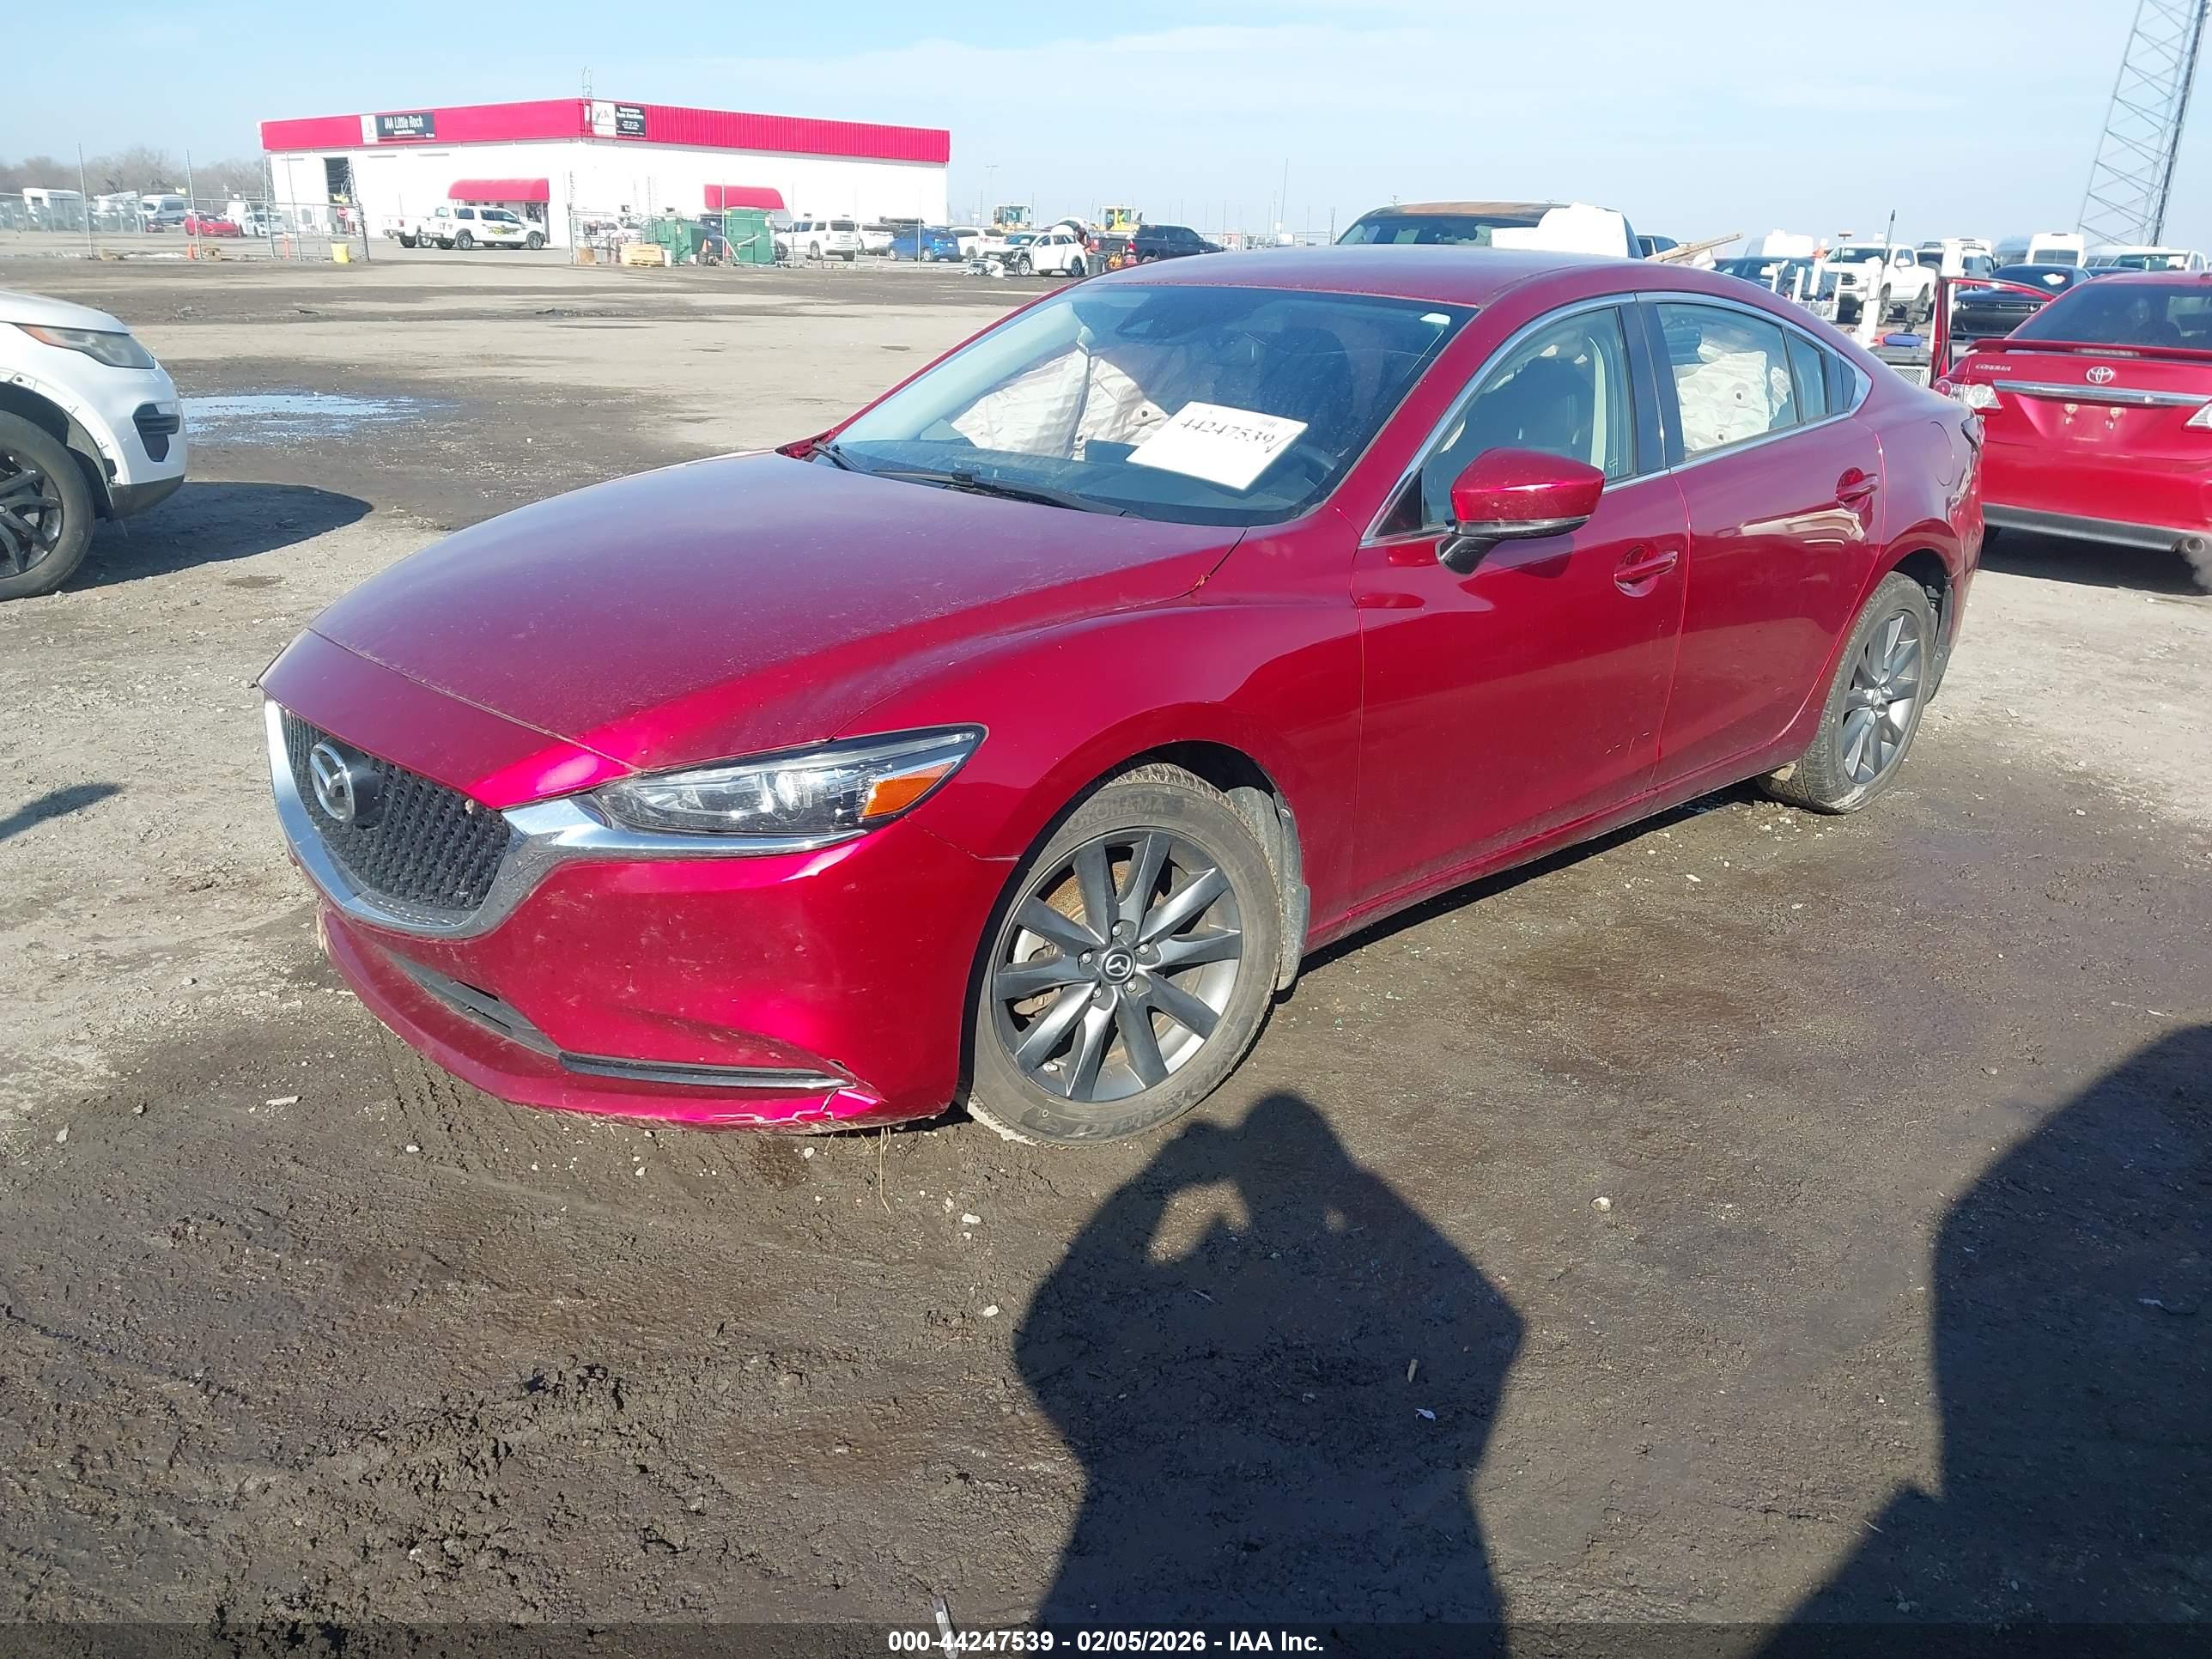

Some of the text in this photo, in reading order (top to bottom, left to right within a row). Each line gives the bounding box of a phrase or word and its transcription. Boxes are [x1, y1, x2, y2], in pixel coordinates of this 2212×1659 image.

[394, 116, 410, 129] Little
[409, 114, 423, 128] Rock
[1181, 418, 1276, 444] 44247539
